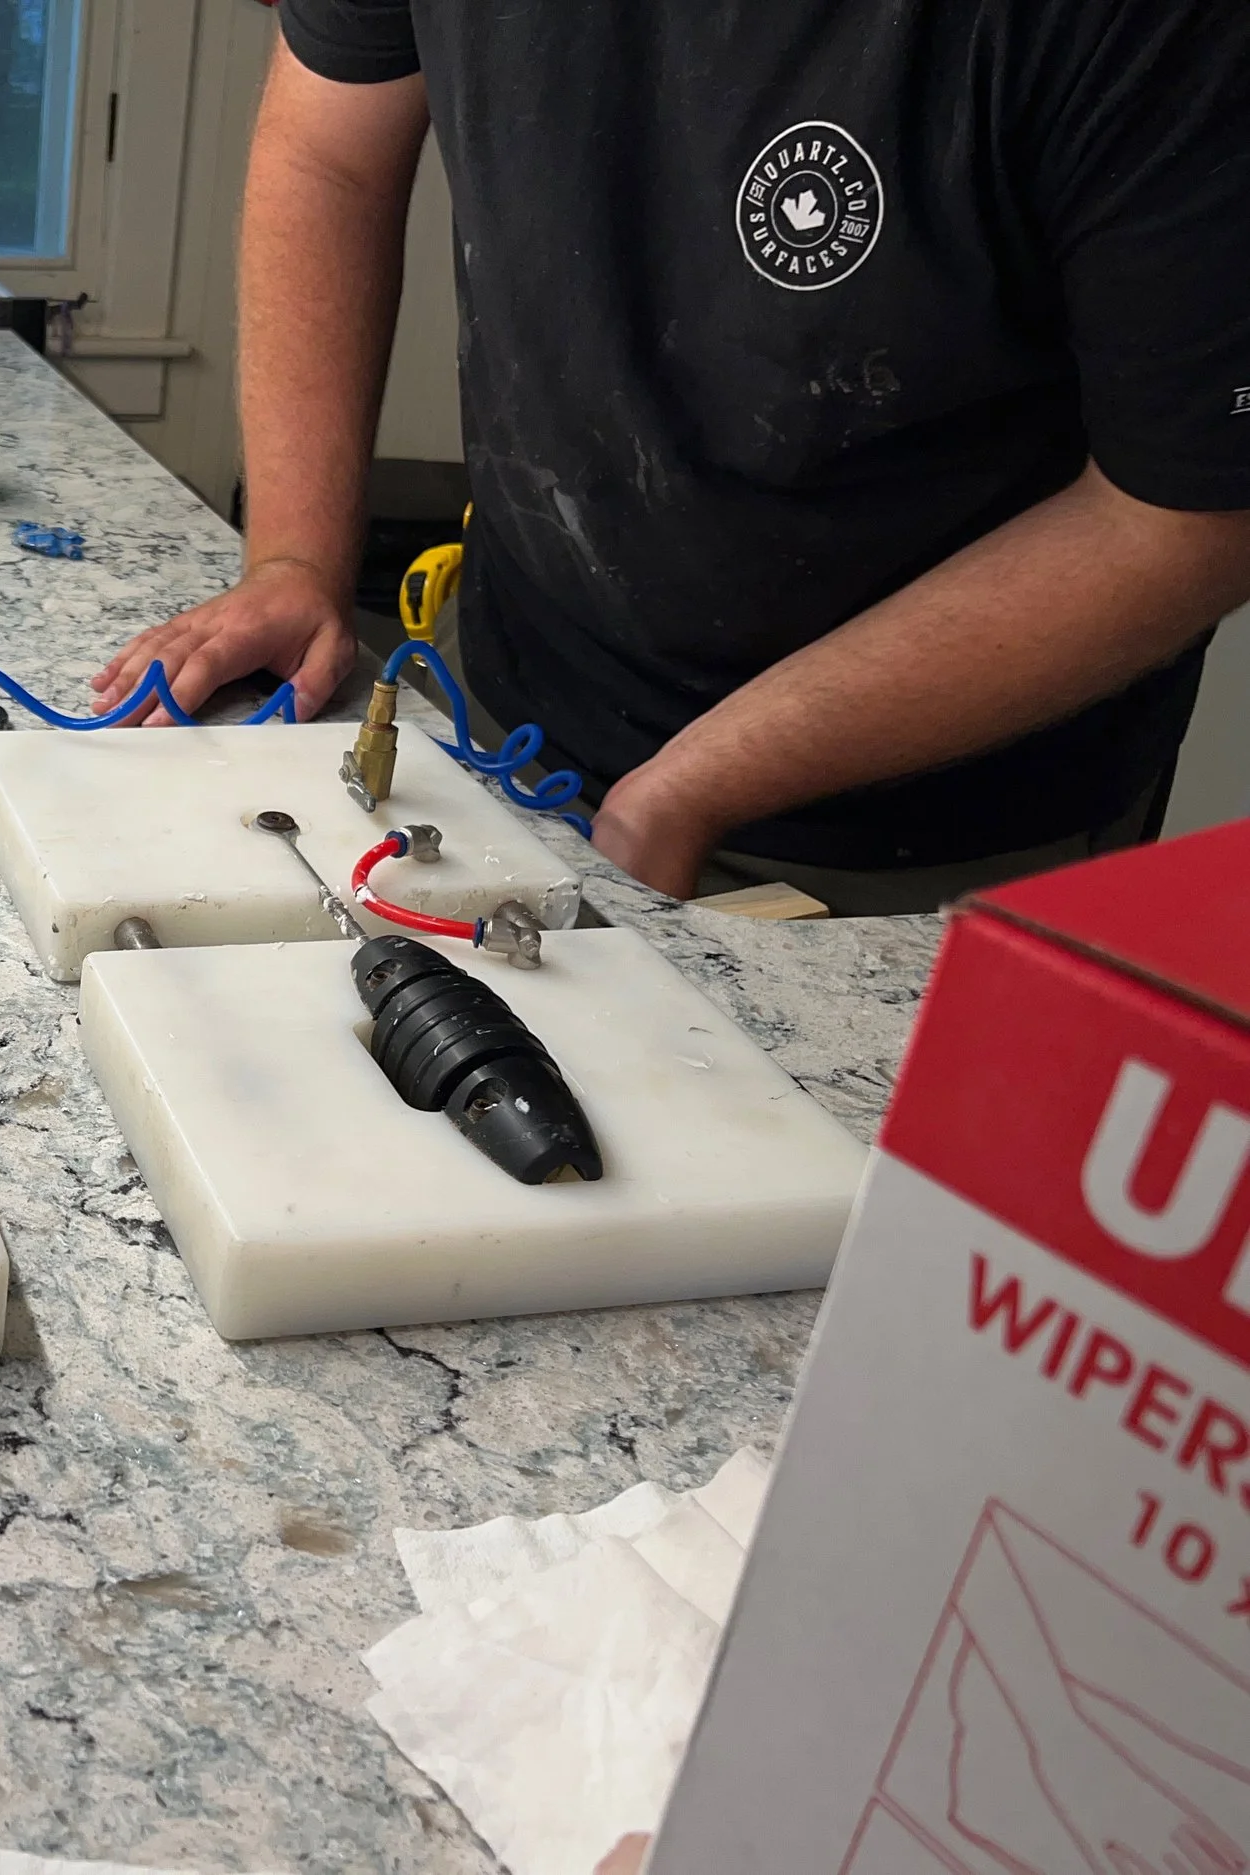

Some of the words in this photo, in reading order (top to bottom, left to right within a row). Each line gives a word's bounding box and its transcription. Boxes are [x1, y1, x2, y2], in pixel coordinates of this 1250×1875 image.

[749, 182, 765, 201] EST.
[750, 212, 847, 274] SURFACES
[839, 220, 870, 238] 2007
[1129, 1489, 1218, 1583] 10
